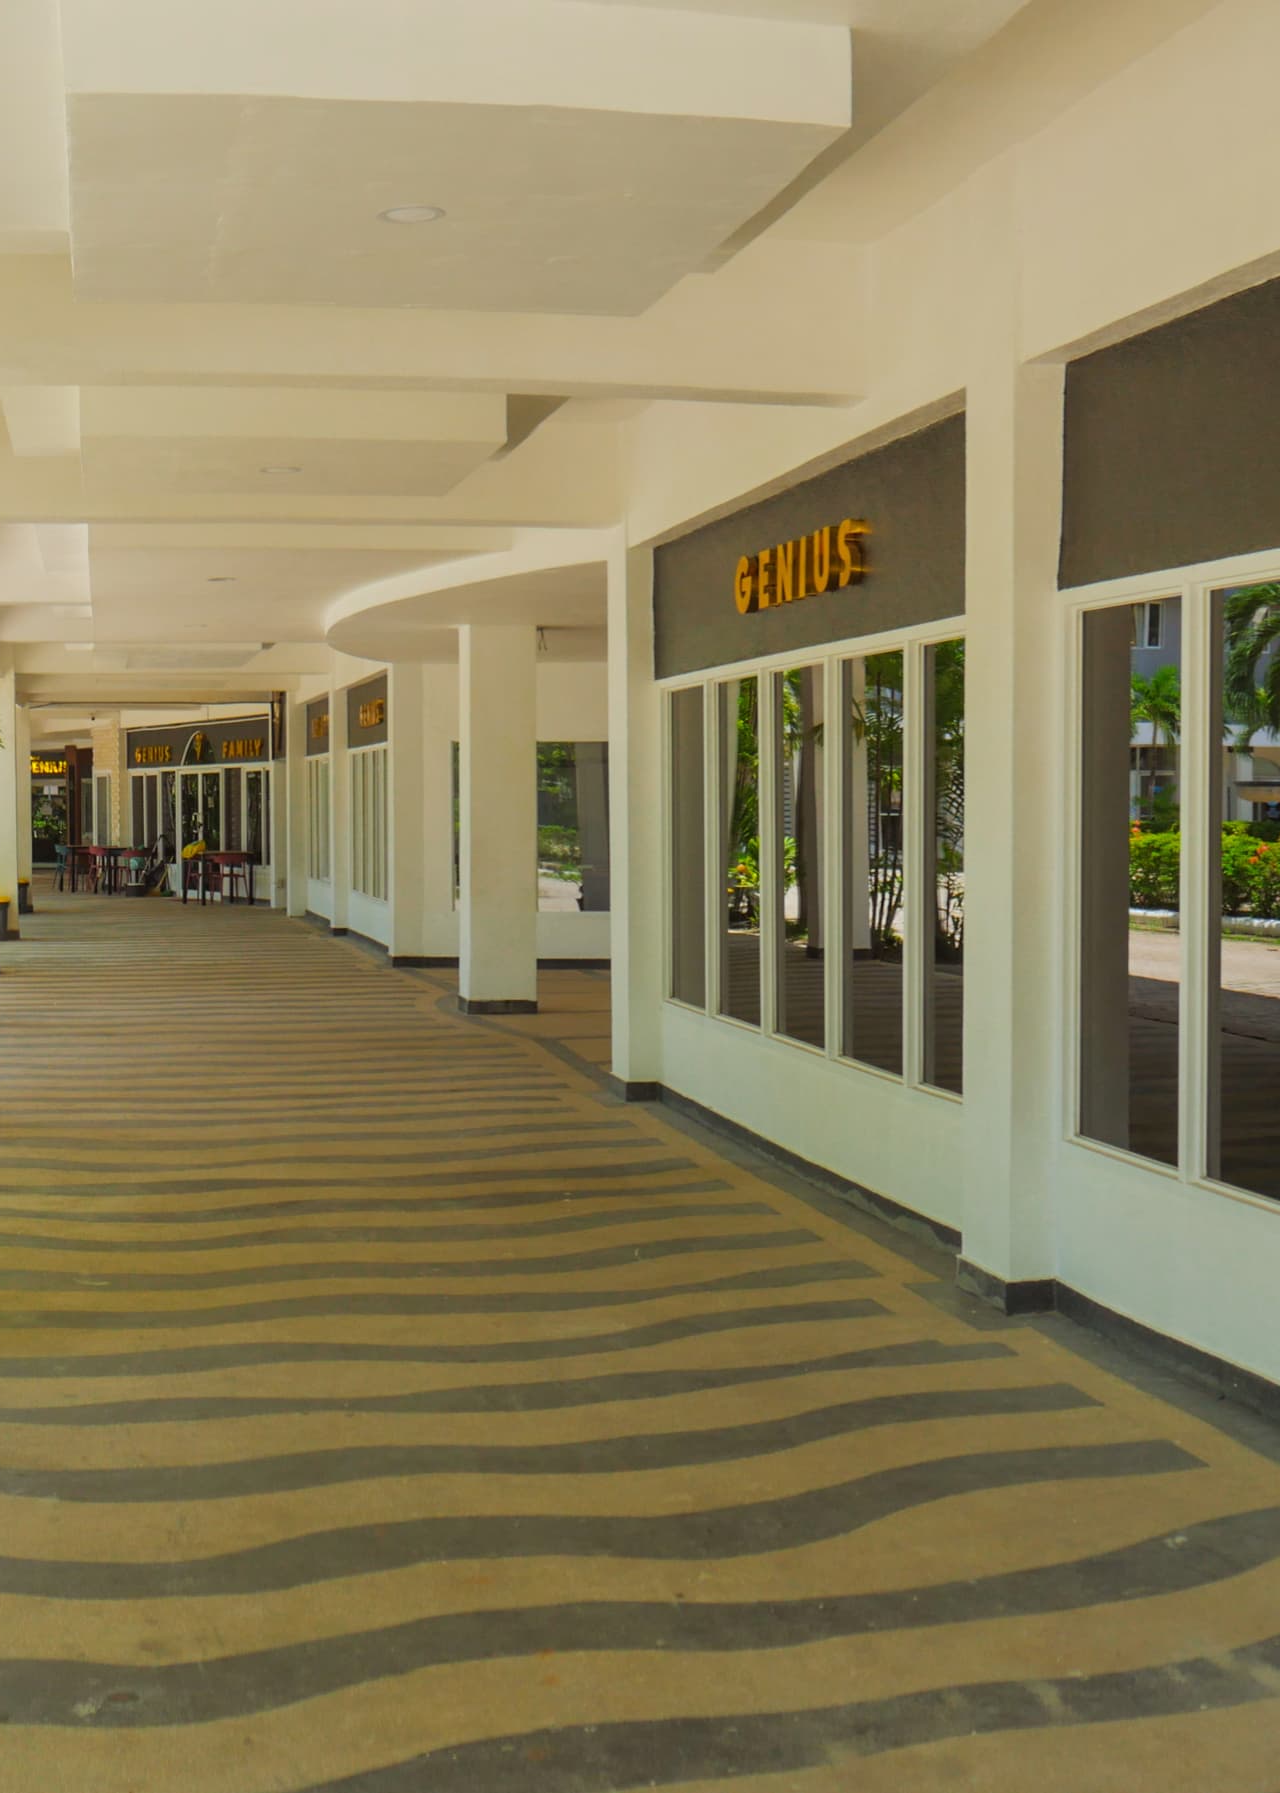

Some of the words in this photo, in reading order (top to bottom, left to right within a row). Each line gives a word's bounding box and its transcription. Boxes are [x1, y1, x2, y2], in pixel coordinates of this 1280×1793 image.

[733, 518, 871, 614] GENIUS
[135, 746, 172, 763] GENIUS
[222, 739, 263, 759] FAMILY
